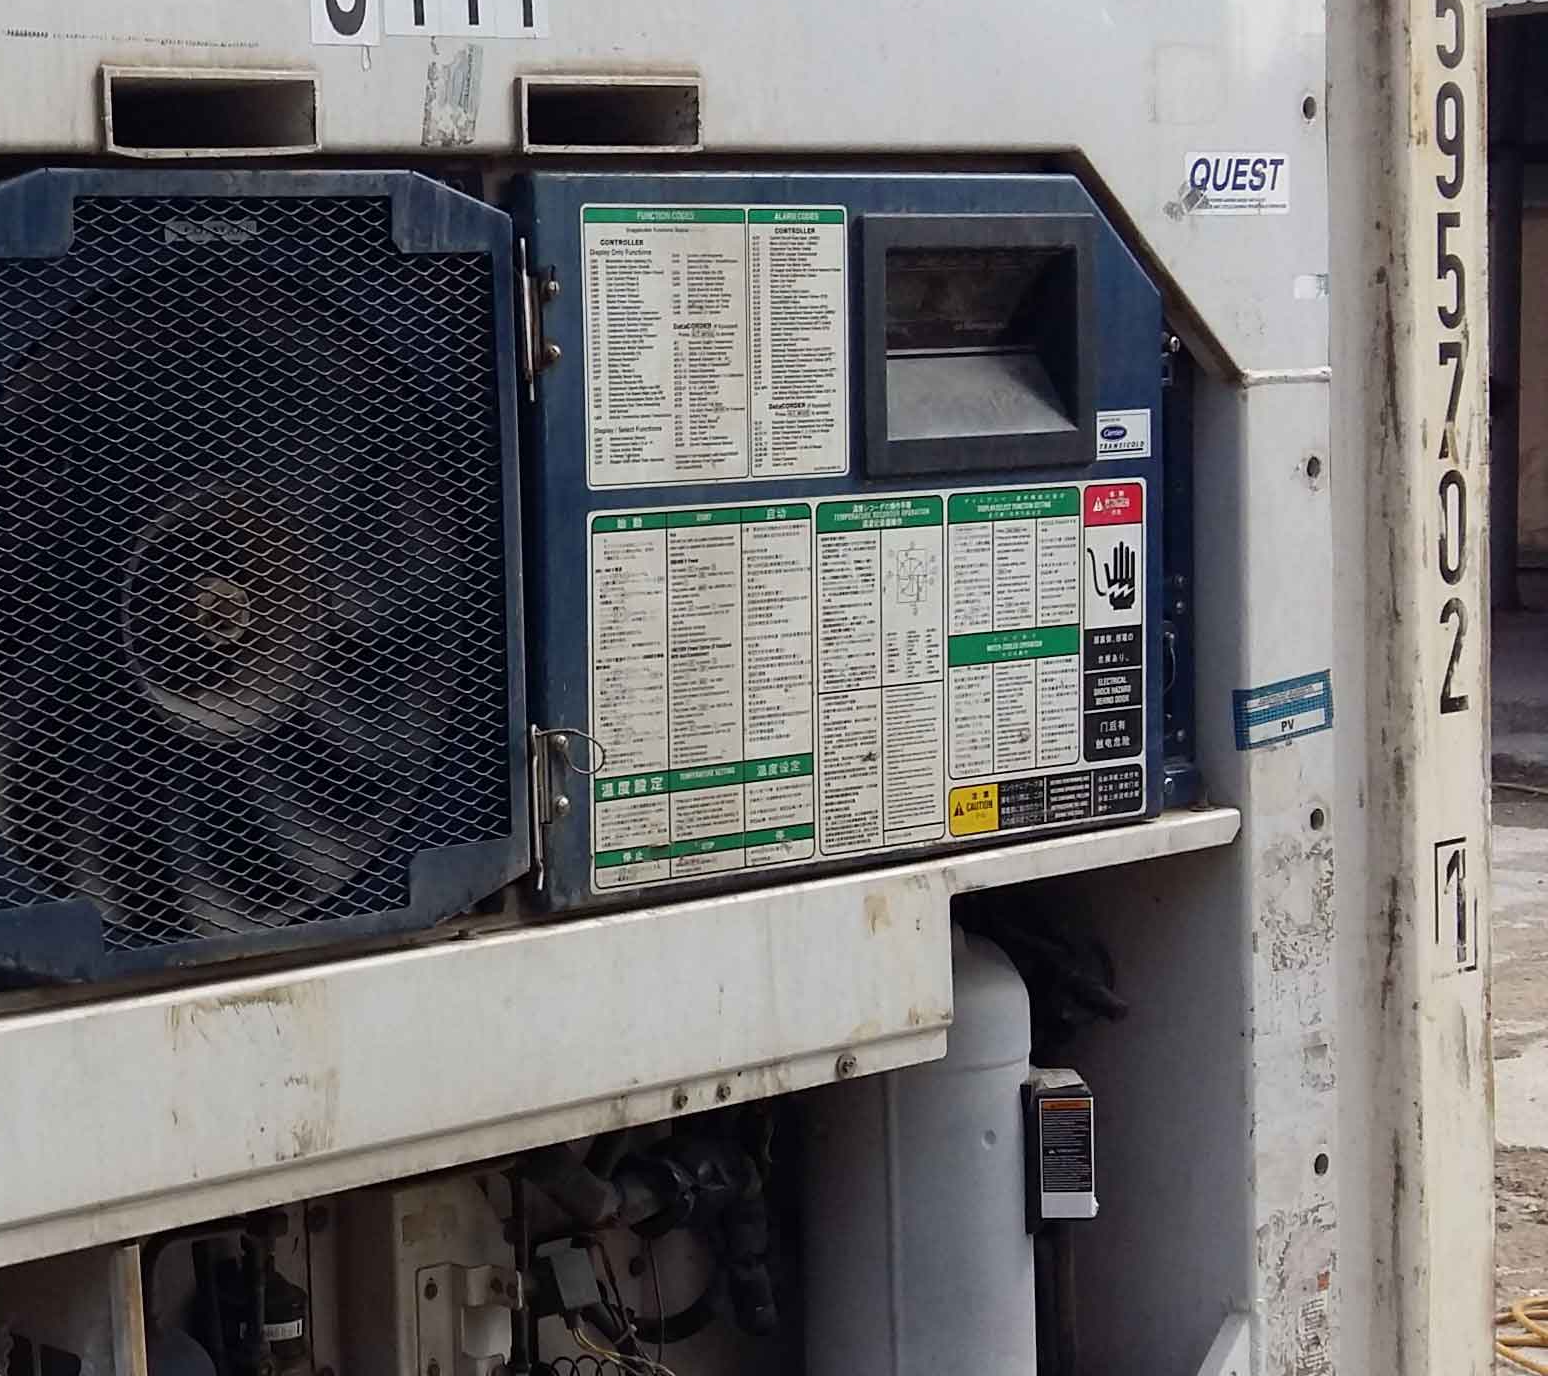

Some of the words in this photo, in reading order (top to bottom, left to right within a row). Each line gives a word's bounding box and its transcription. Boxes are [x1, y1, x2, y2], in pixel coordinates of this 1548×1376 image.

[1189, 158, 1285, 193] QUEST
[1280, 719, 1295, 732] PV
[966, 800, 993, 812] CAUTION
